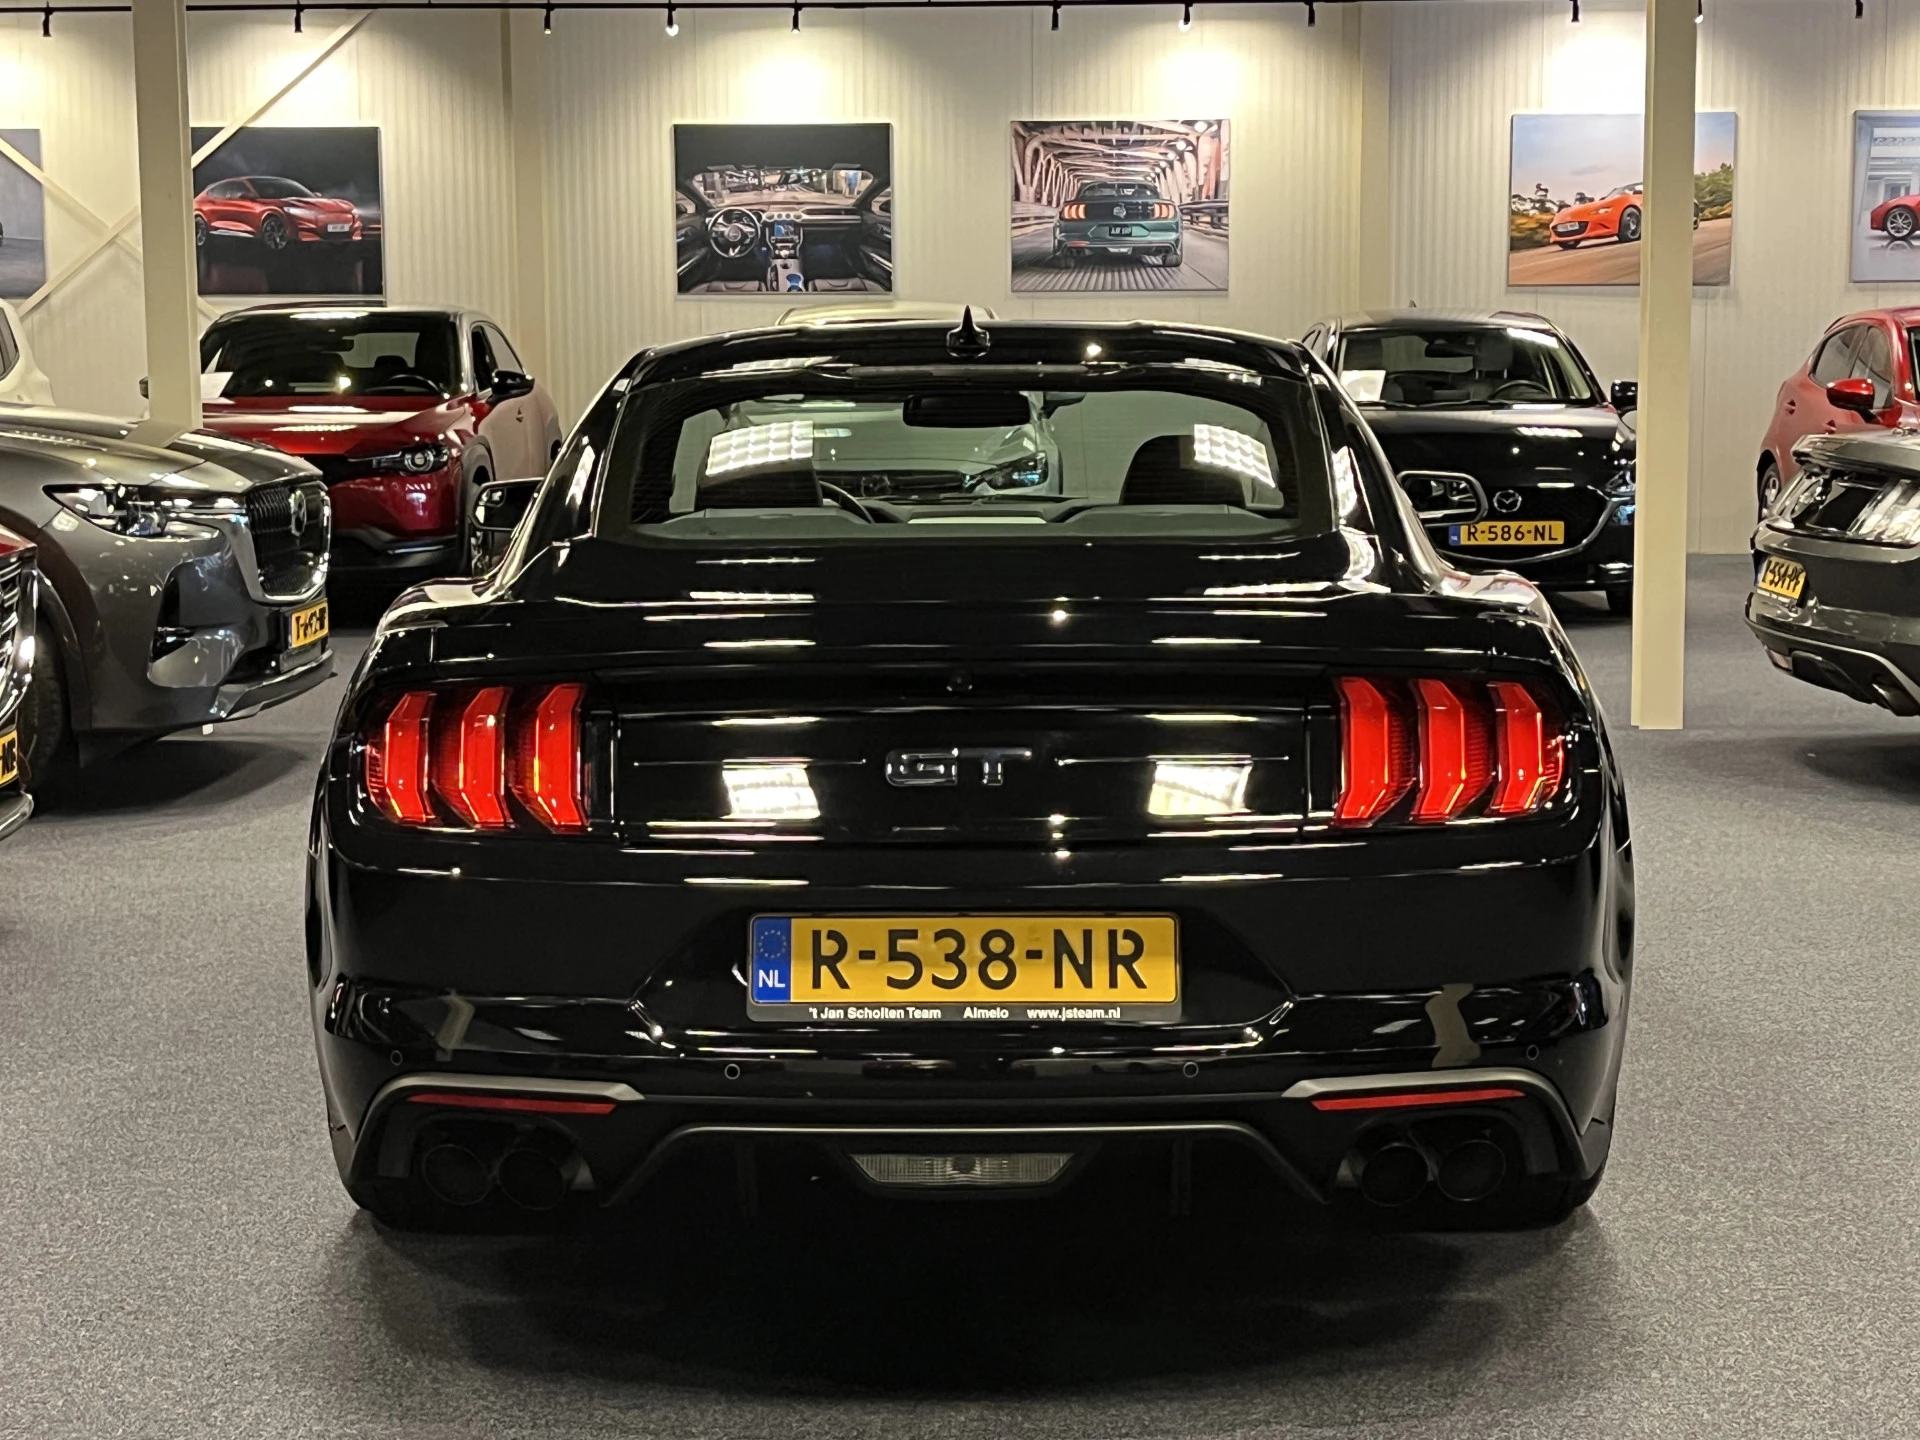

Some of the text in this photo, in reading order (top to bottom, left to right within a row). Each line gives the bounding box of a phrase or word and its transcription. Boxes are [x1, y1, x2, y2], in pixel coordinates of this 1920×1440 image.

[1467, 524, 1558, 542] R-586-NL
[884, 747, 1032, 787] GT
[759, 928, 1149, 990] NL R-538-NR
[820, 1007, 844, 1019] Jan
[847, 1007, 904, 1019] Scholten
[906, 1007, 941, 1019] Team
[963, 1006, 1009, 1019] Almelo
[1026, 1006, 1121, 1022] www.jsteam.nl
